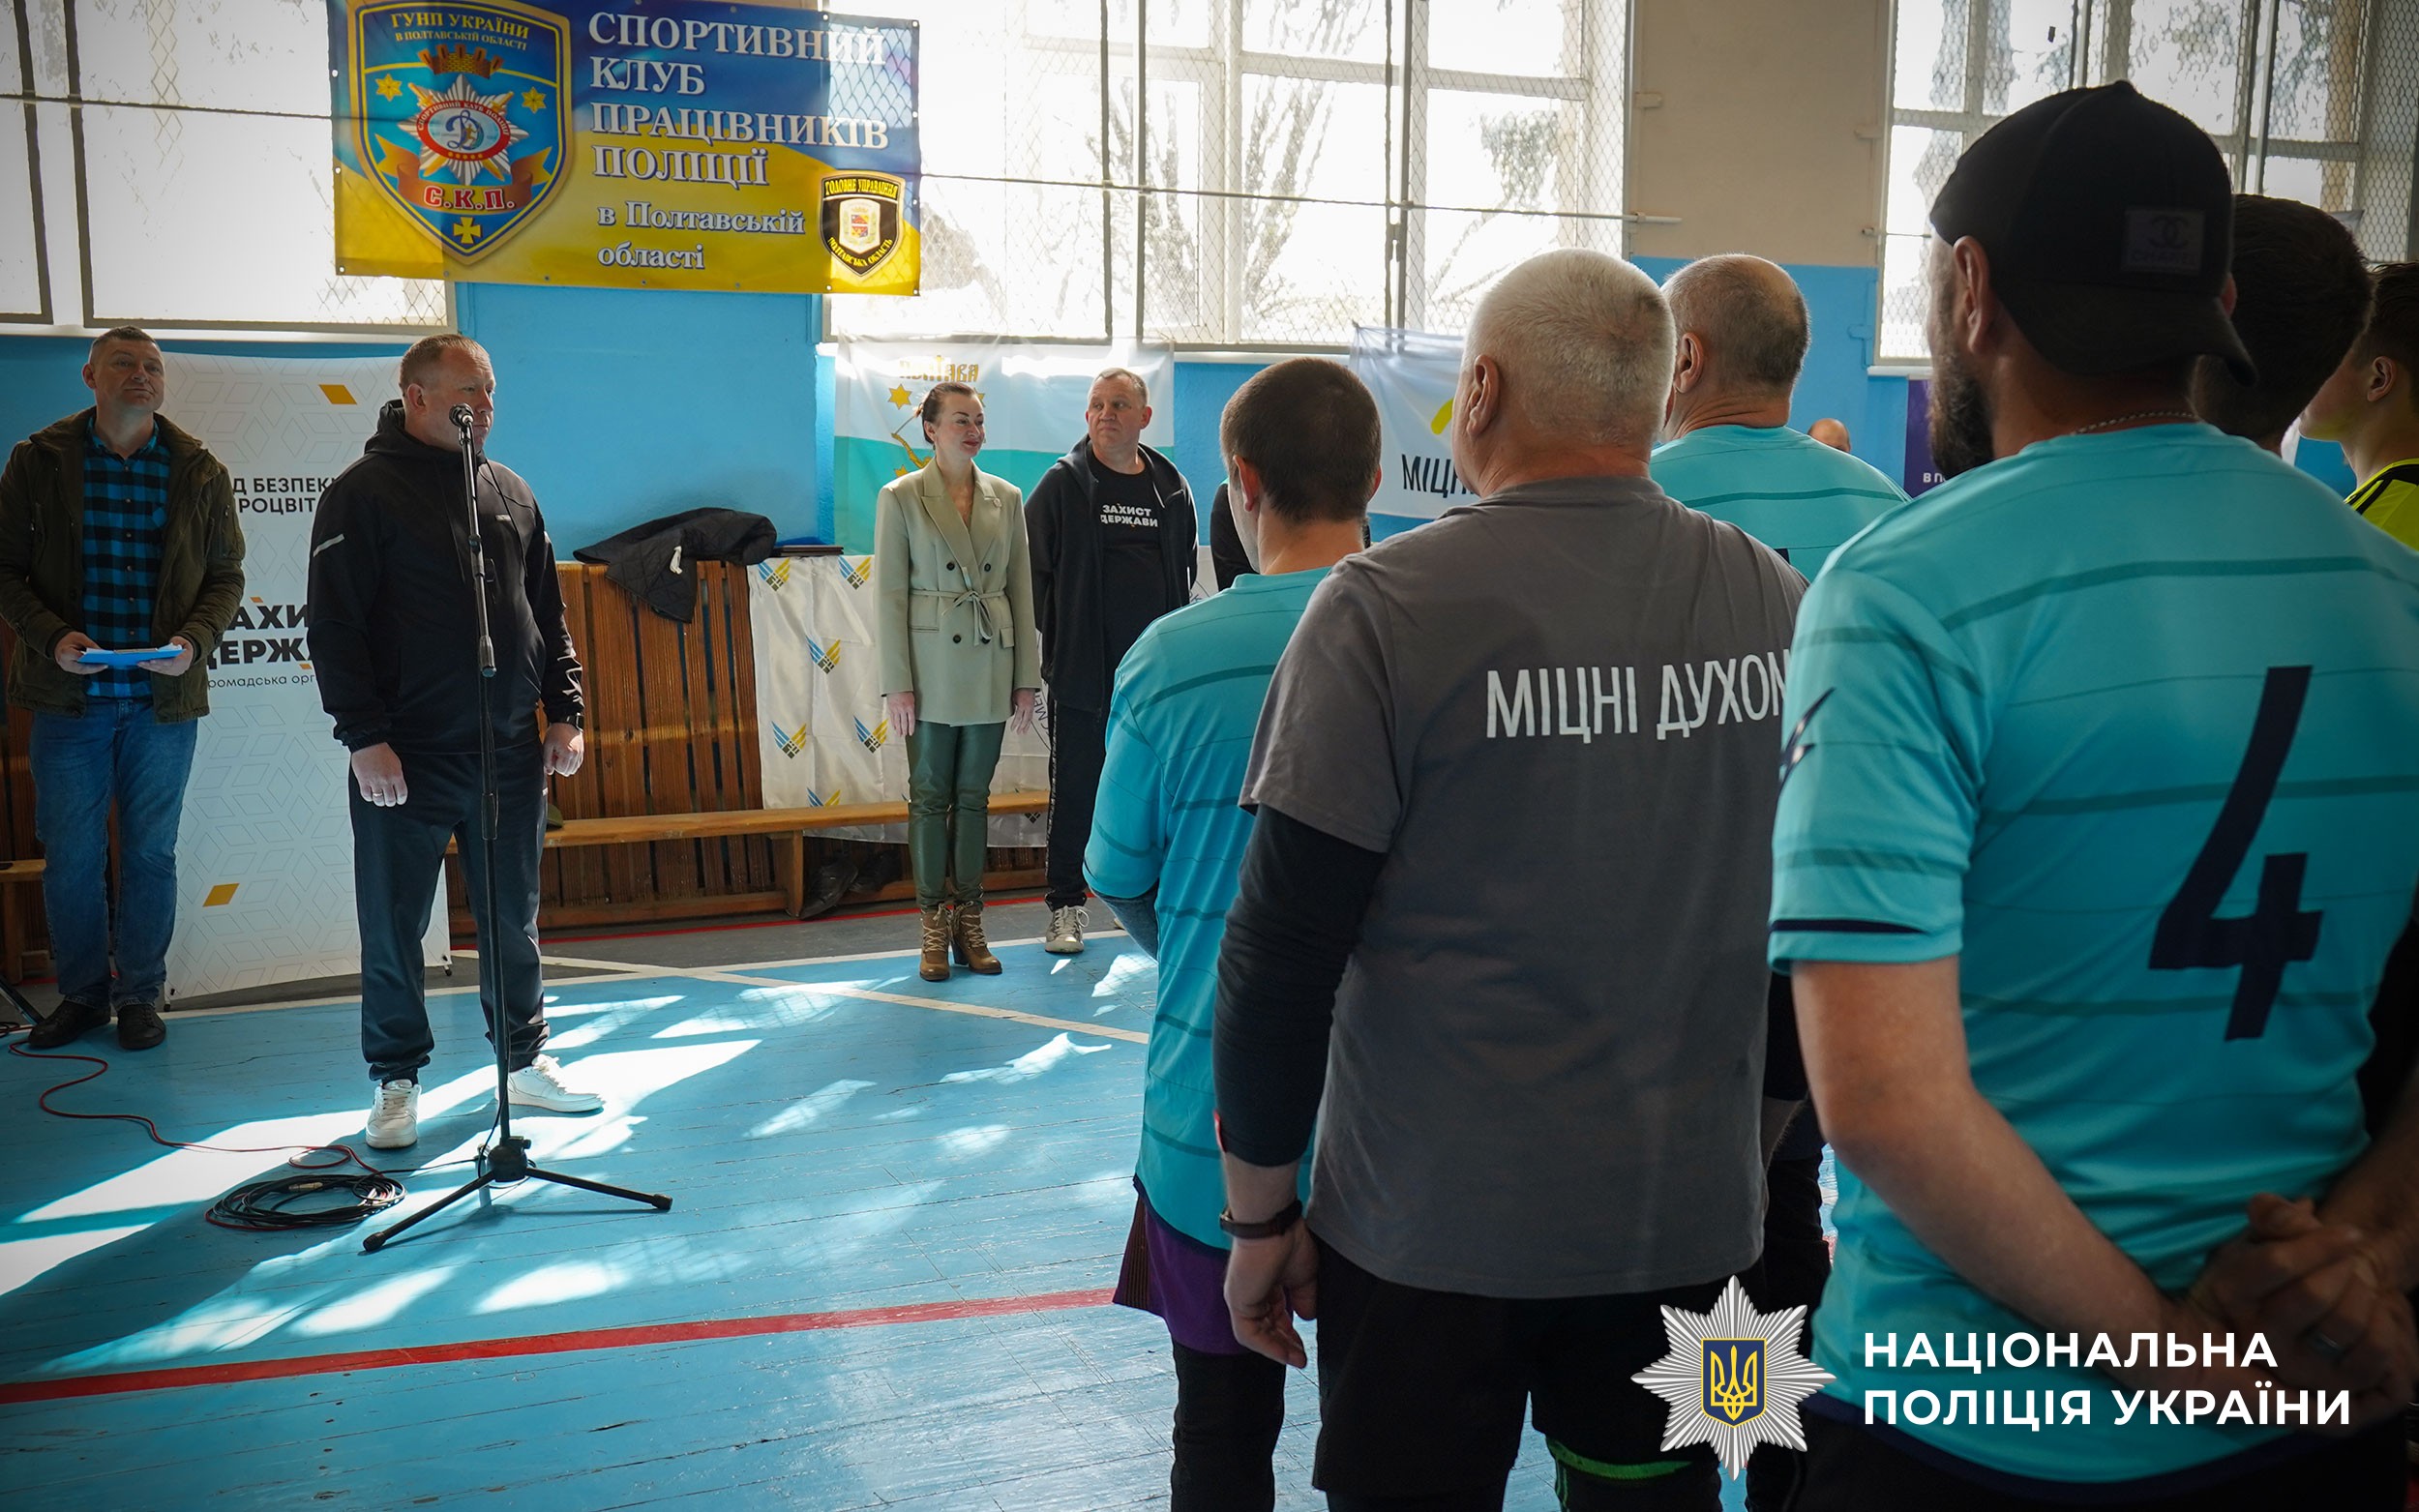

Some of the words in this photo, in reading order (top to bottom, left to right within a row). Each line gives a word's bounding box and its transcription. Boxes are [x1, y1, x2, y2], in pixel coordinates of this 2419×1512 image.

[390, 12, 444, 28] ГУНП
[448, 14, 529, 40] УКРАЇНИ
[588, 11, 887, 66] СПОРТИВНИЙ
[481, 35, 527, 50] ОБЛАСТІ
[589, 56, 706, 95] КЛУБ
[589, 101, 889, 150] ПРАЦІВНИКІВ
[590, 145, 769, 190] ПОЛІЦІЇ
[423, 185, 515, 211] С.К.П.
[597, 205, 616, 226] в
[625, 199, 806, 235] Полтавській
[597, 241, 705, 270] області
[253, 477, 335, 493] БЕЗПЕК
[1401, 453, 1475, 499] МІЦ
[1933, 472, 1946, 484] П
[238, 497, 316, 516] РОЦВІТ
[1102, 504, 1152, 518] ЗАХИСТ
[1100, 515, 1158, 528] ДЕРЖАВИ
[225, 604, 310, 632] АХИ
[207, 637, 311, 670] ЕРЖ
[208, 675, 287, 691] ромадська
[290, 673, 315, 686] орг
[1486, 666, 1638, 744] МІЦНІ
[2148, 664, 2323, 1042] 4
